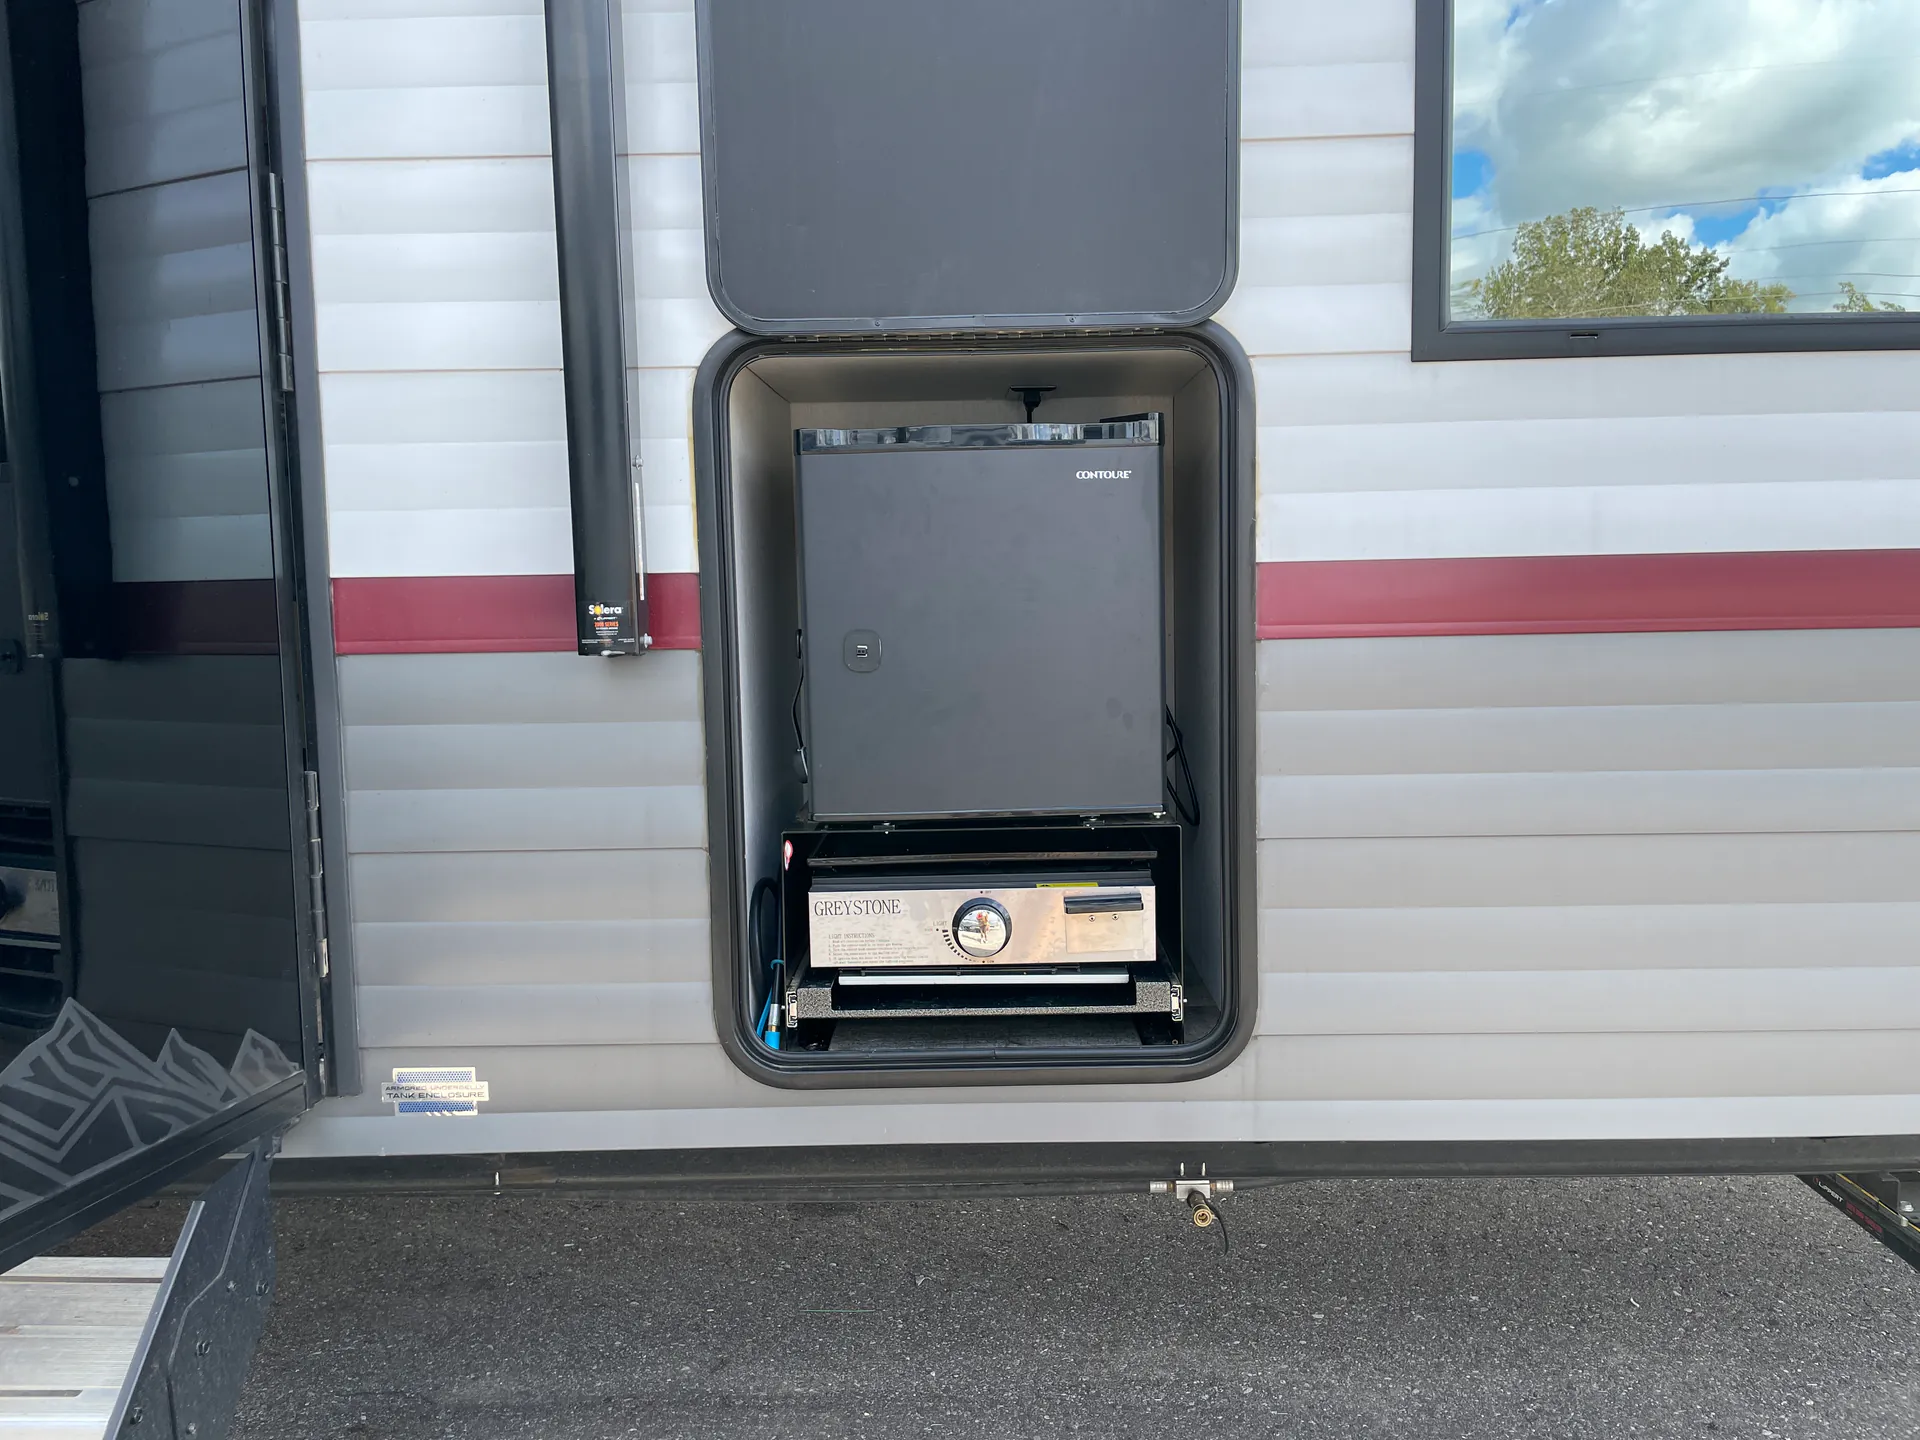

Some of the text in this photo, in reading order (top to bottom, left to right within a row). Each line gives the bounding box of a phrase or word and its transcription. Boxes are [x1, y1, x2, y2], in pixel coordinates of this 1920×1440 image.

[1075, 470, 1130, 480] CONTOURE
[588, 604, 622, 615] Solera
[814, 899, 901, 916] GREYSTONE
